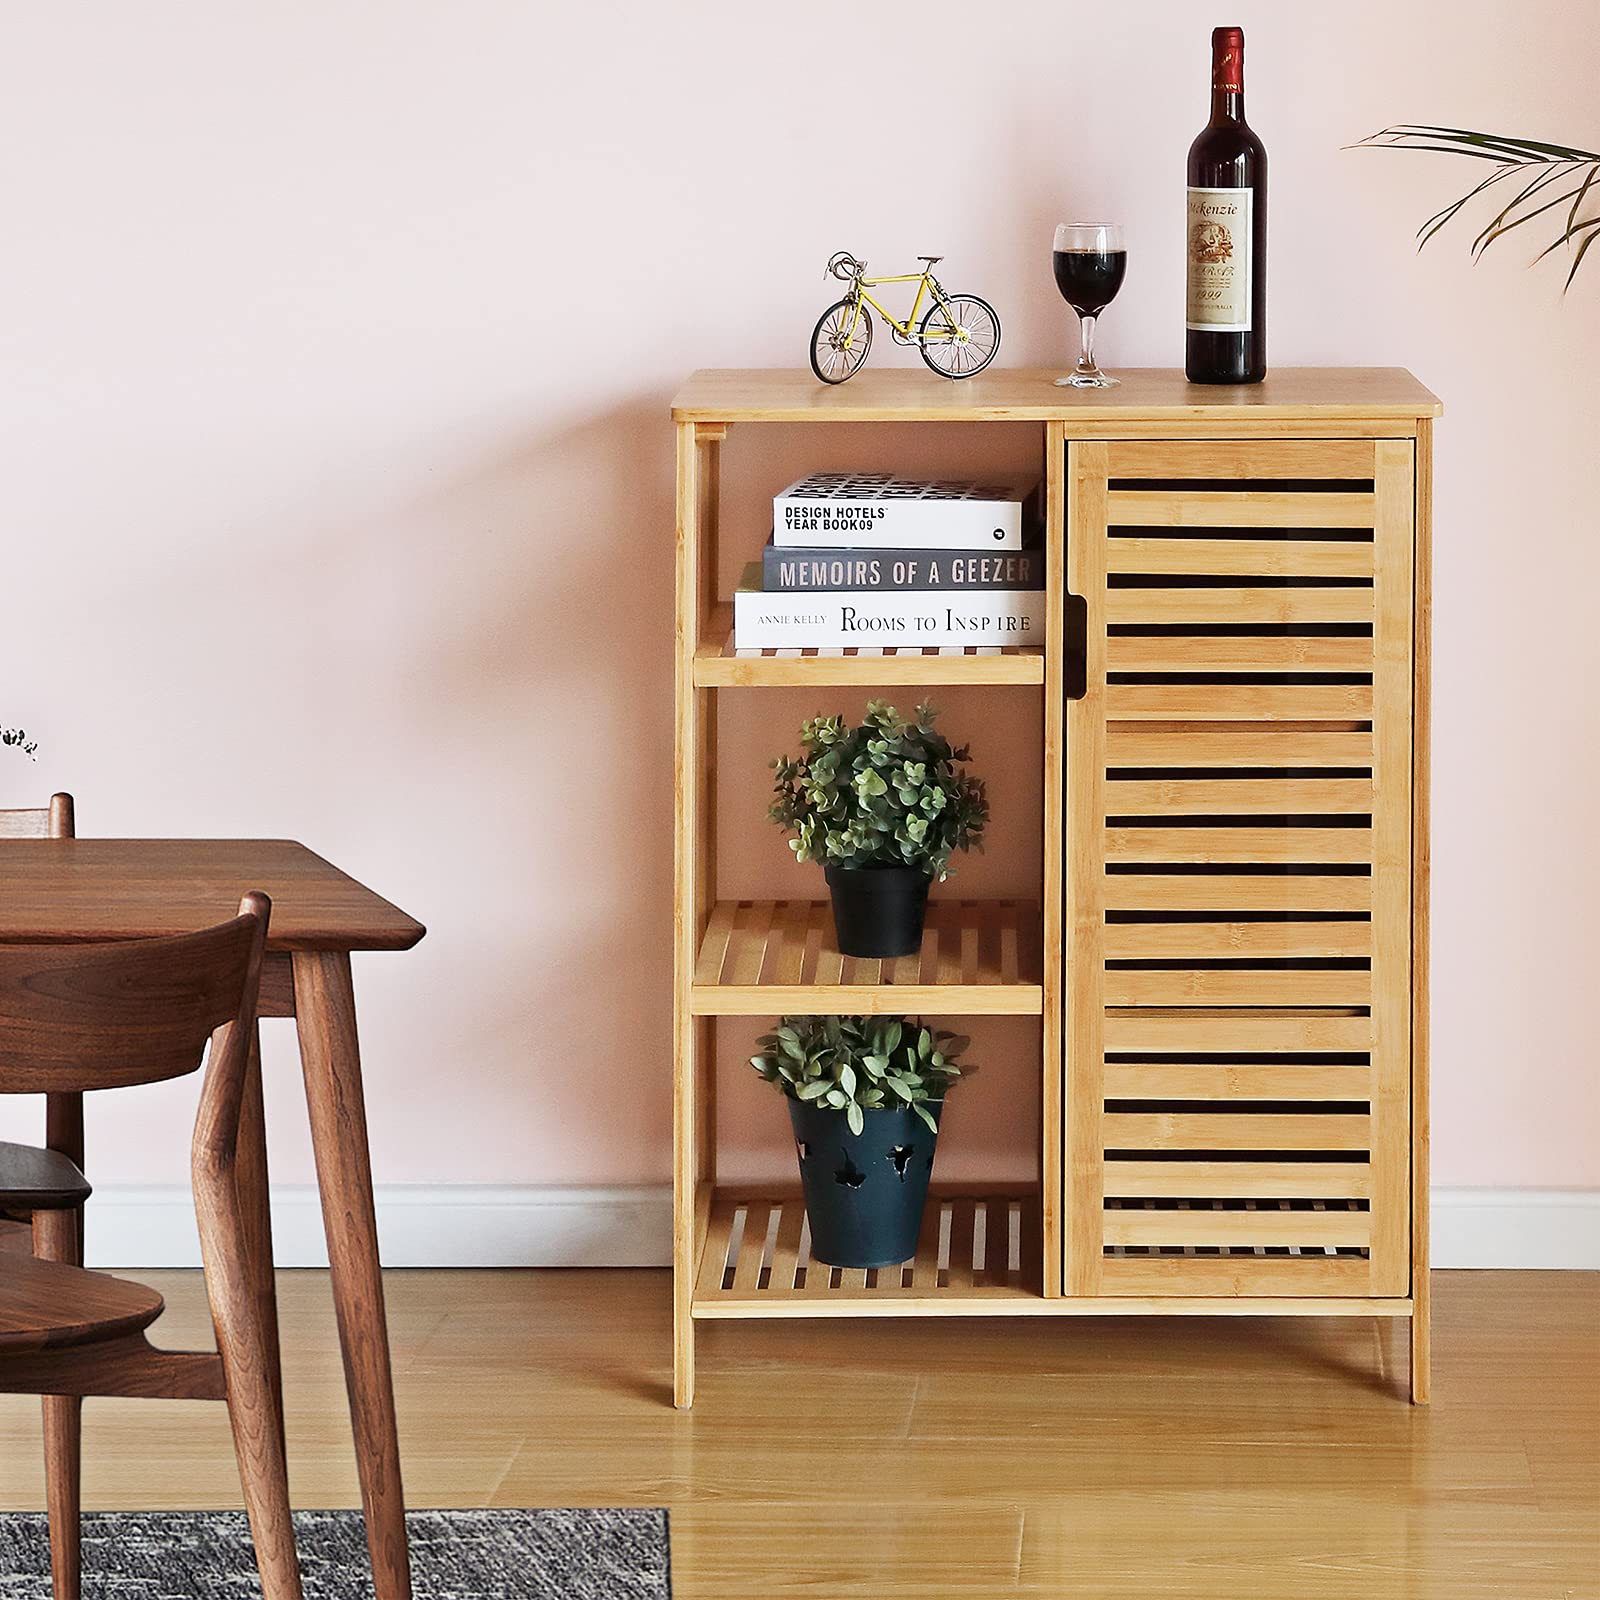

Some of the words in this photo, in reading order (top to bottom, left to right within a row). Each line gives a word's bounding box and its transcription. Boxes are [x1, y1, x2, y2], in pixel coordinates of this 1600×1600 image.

[785, 507, 831, 518] DESIGN
[785, 519, 818, 530] YEAR
[779, 560, 881, 587] MEMOIRS
[893, 561, 918, 585] OF
[928, 560, 940, 584] A
[952, 558, 1031, 584] GEEZER
[757, 615, 791, 625] ANNIE
[793, 615, 828, 625] KELLY
